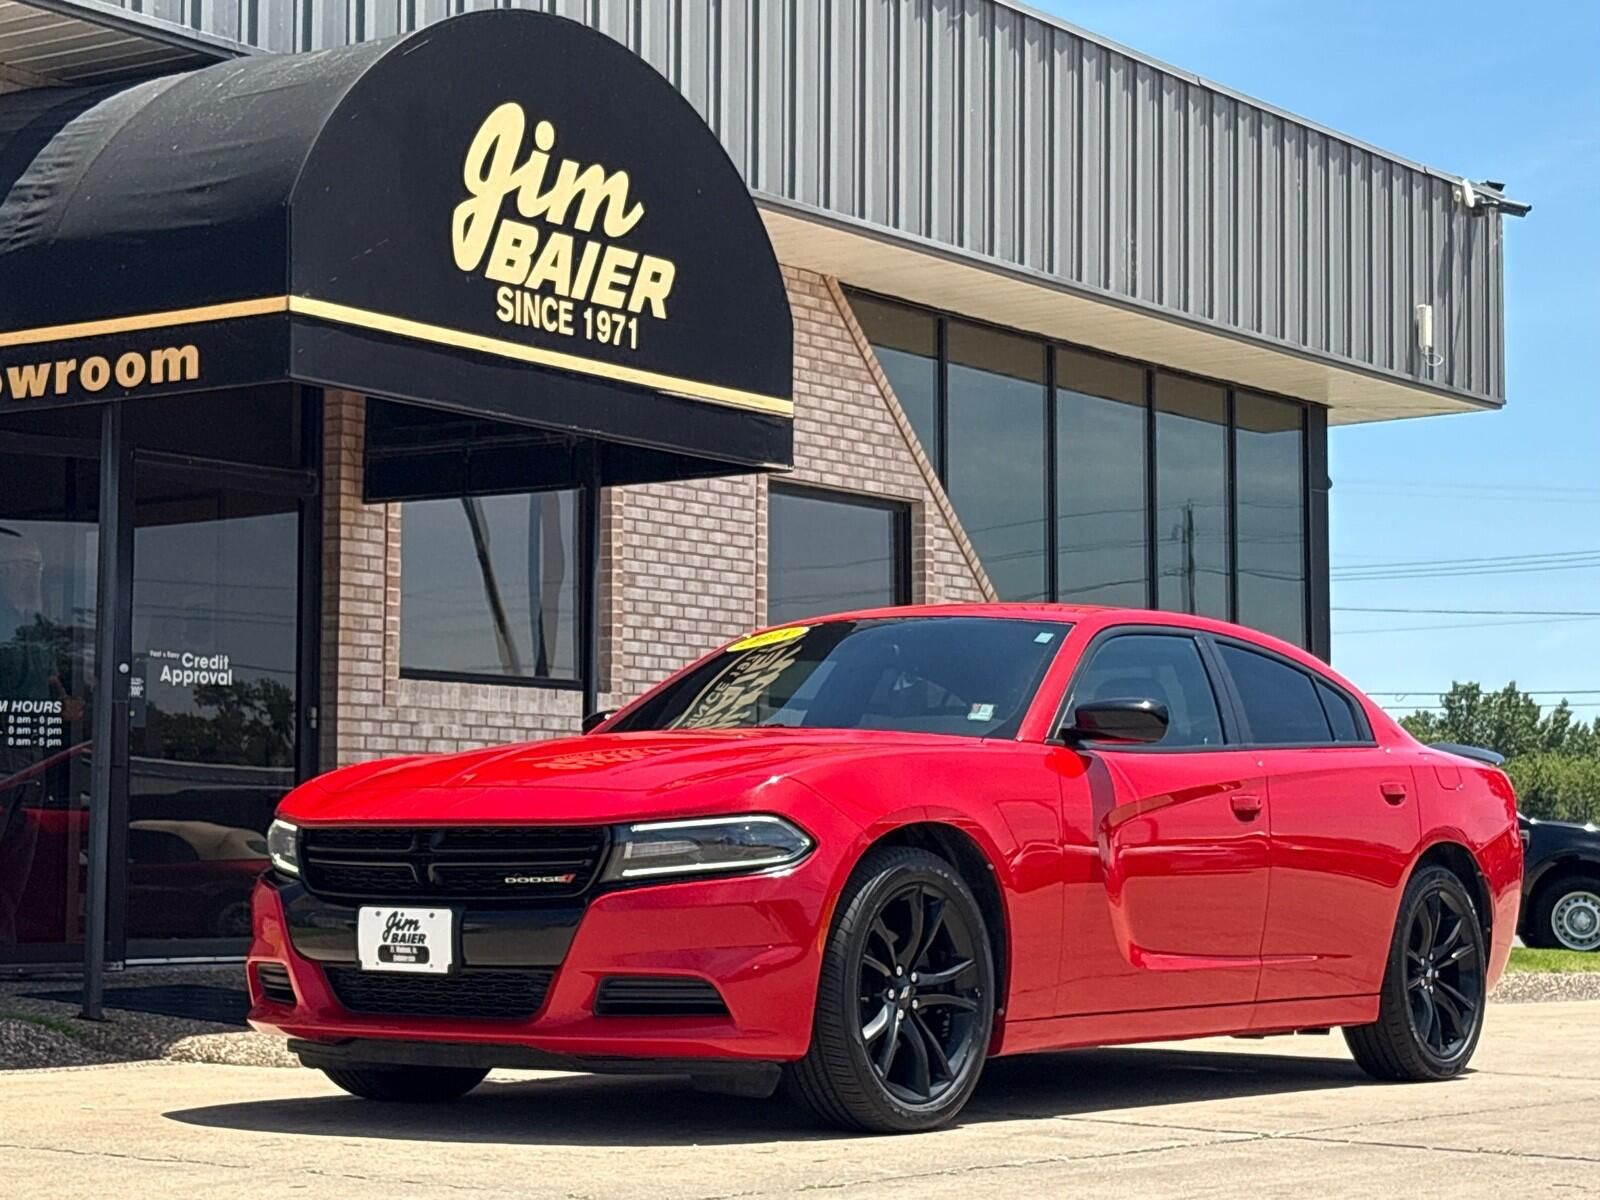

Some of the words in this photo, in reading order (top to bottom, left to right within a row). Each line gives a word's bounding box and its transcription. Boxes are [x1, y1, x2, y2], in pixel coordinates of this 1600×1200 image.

[452, 102, 645, 272] Jim
[484, 218, 676, 320] BAIER
[496, 286, 575, 336] SINCE
[583, 307, 638, 350] 1971
[0, 344, 199, 399] wroom
[182, 652, 229, 669] Credit
[160, 665, 232, 686] Approval
[11, 700, 62, 713] HOURS
[47, 717, 62, 726] pm
[16, 727, 31, 735] am
[47, 727, 62, 737] pm
[47, 739, 62, 748] pm
[505, 876, 563, 884] DODGE
[382, 911, 420, 942] Jim
[390, 933, 427, 945] BAIER
